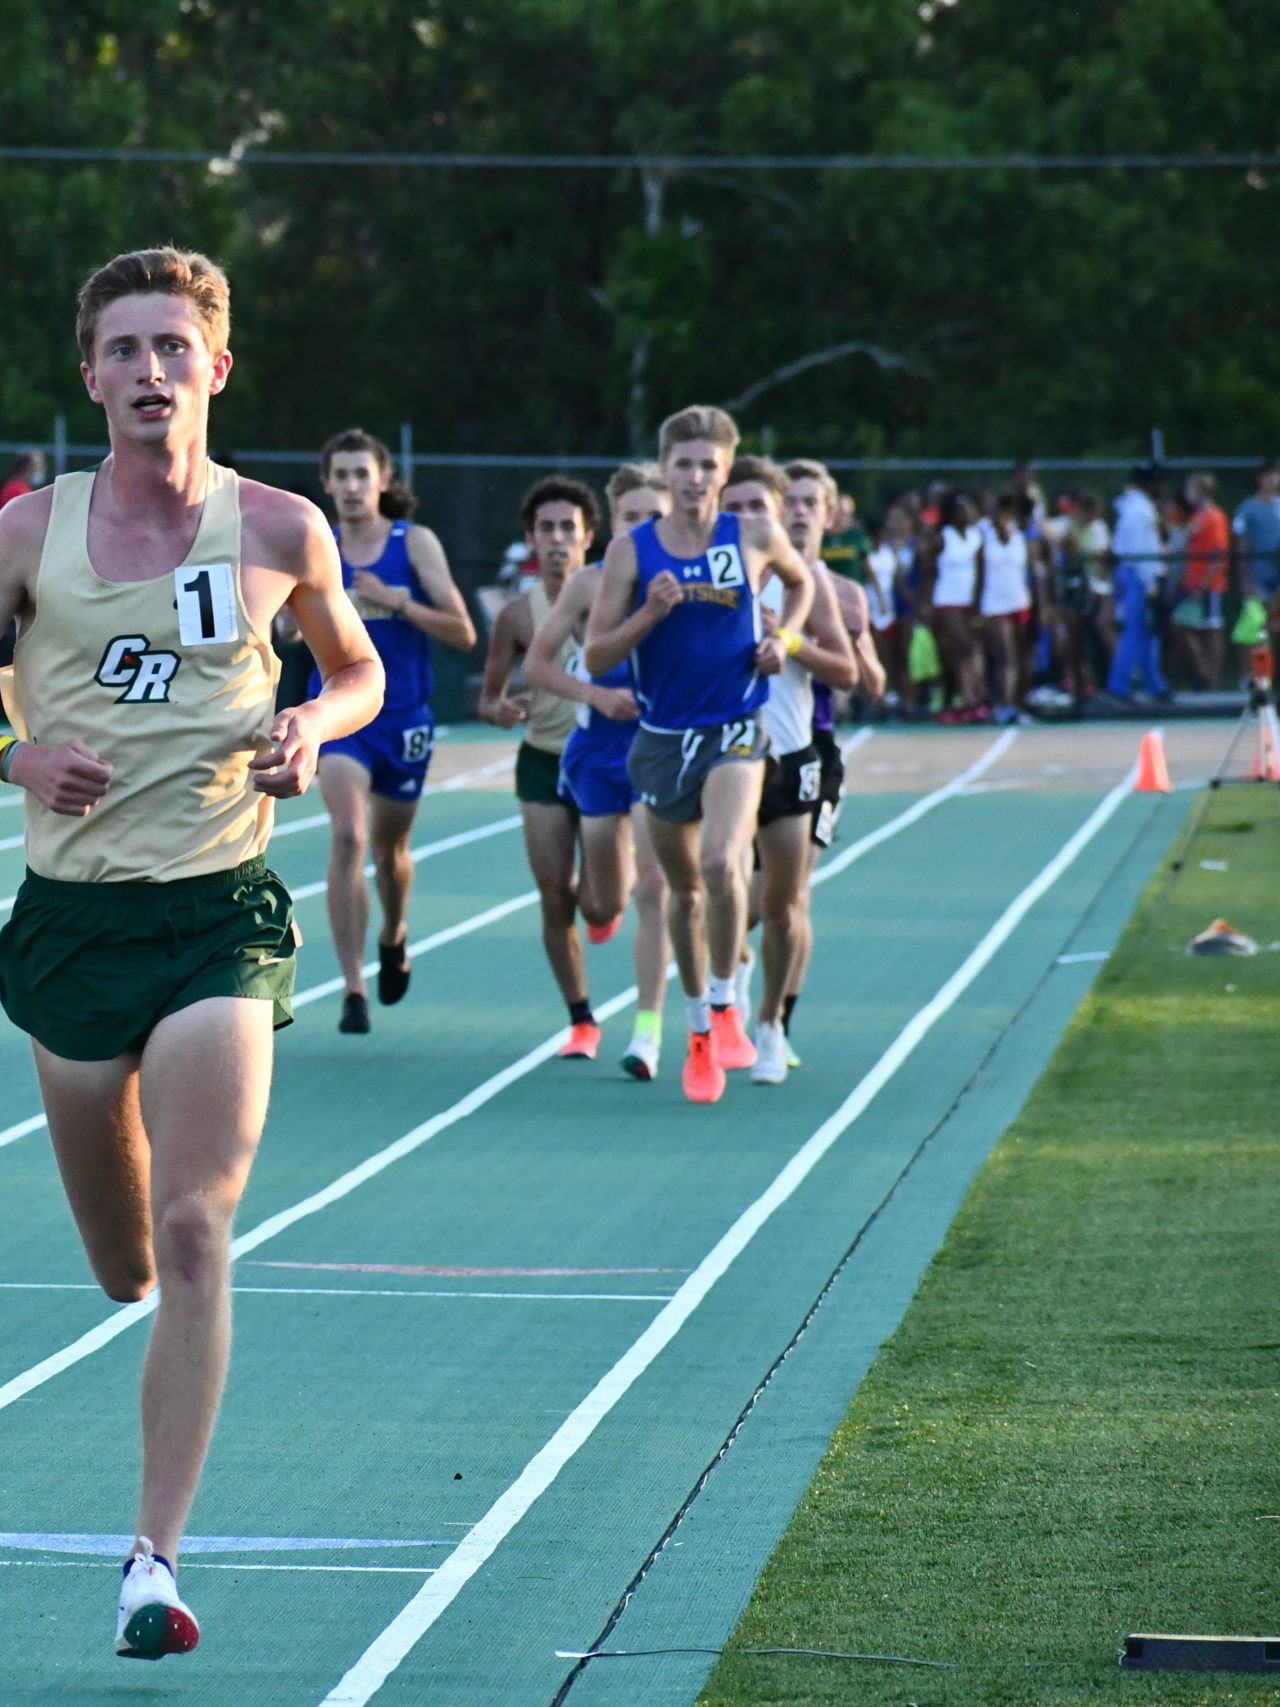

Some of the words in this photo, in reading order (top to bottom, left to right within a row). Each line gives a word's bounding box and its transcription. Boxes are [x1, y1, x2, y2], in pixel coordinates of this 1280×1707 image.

[712, 550, 736, 583] 2
[184, 571, 216, 639] 1
[676, 582, 738, 608] TSIDE
[94, 634, 182, 704] CR
[726, 719, 748, 747] 2
